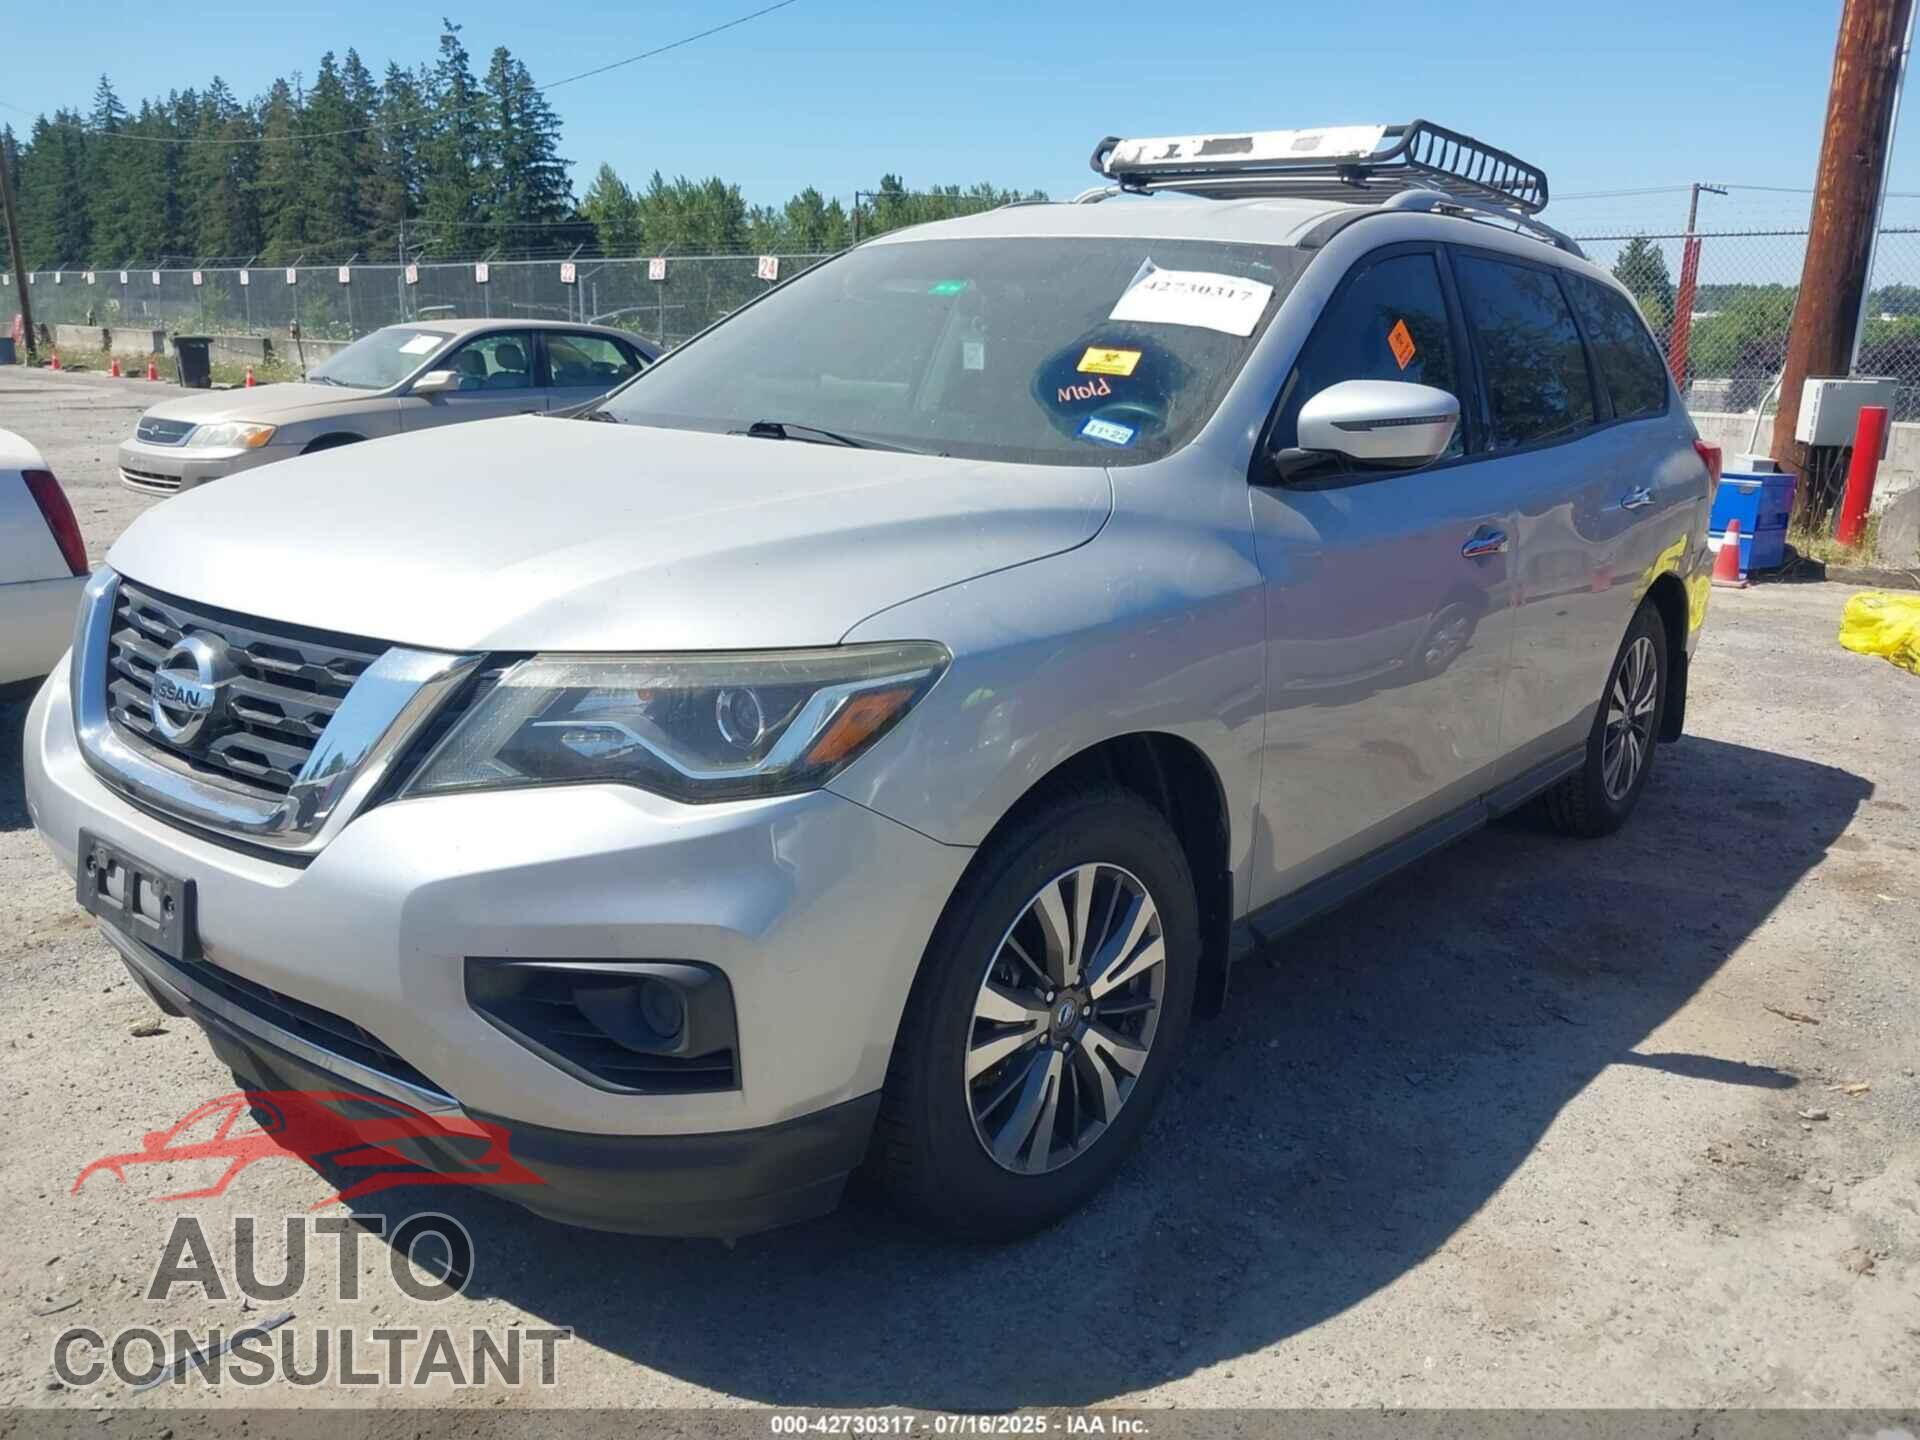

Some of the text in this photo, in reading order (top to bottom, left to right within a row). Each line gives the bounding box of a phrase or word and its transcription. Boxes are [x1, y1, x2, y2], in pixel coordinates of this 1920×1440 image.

[1144, 280, 1254, 301] 42730317
[1057, 377, 1112, 403] Mold
[153, 682, 200, 706] SSAN
